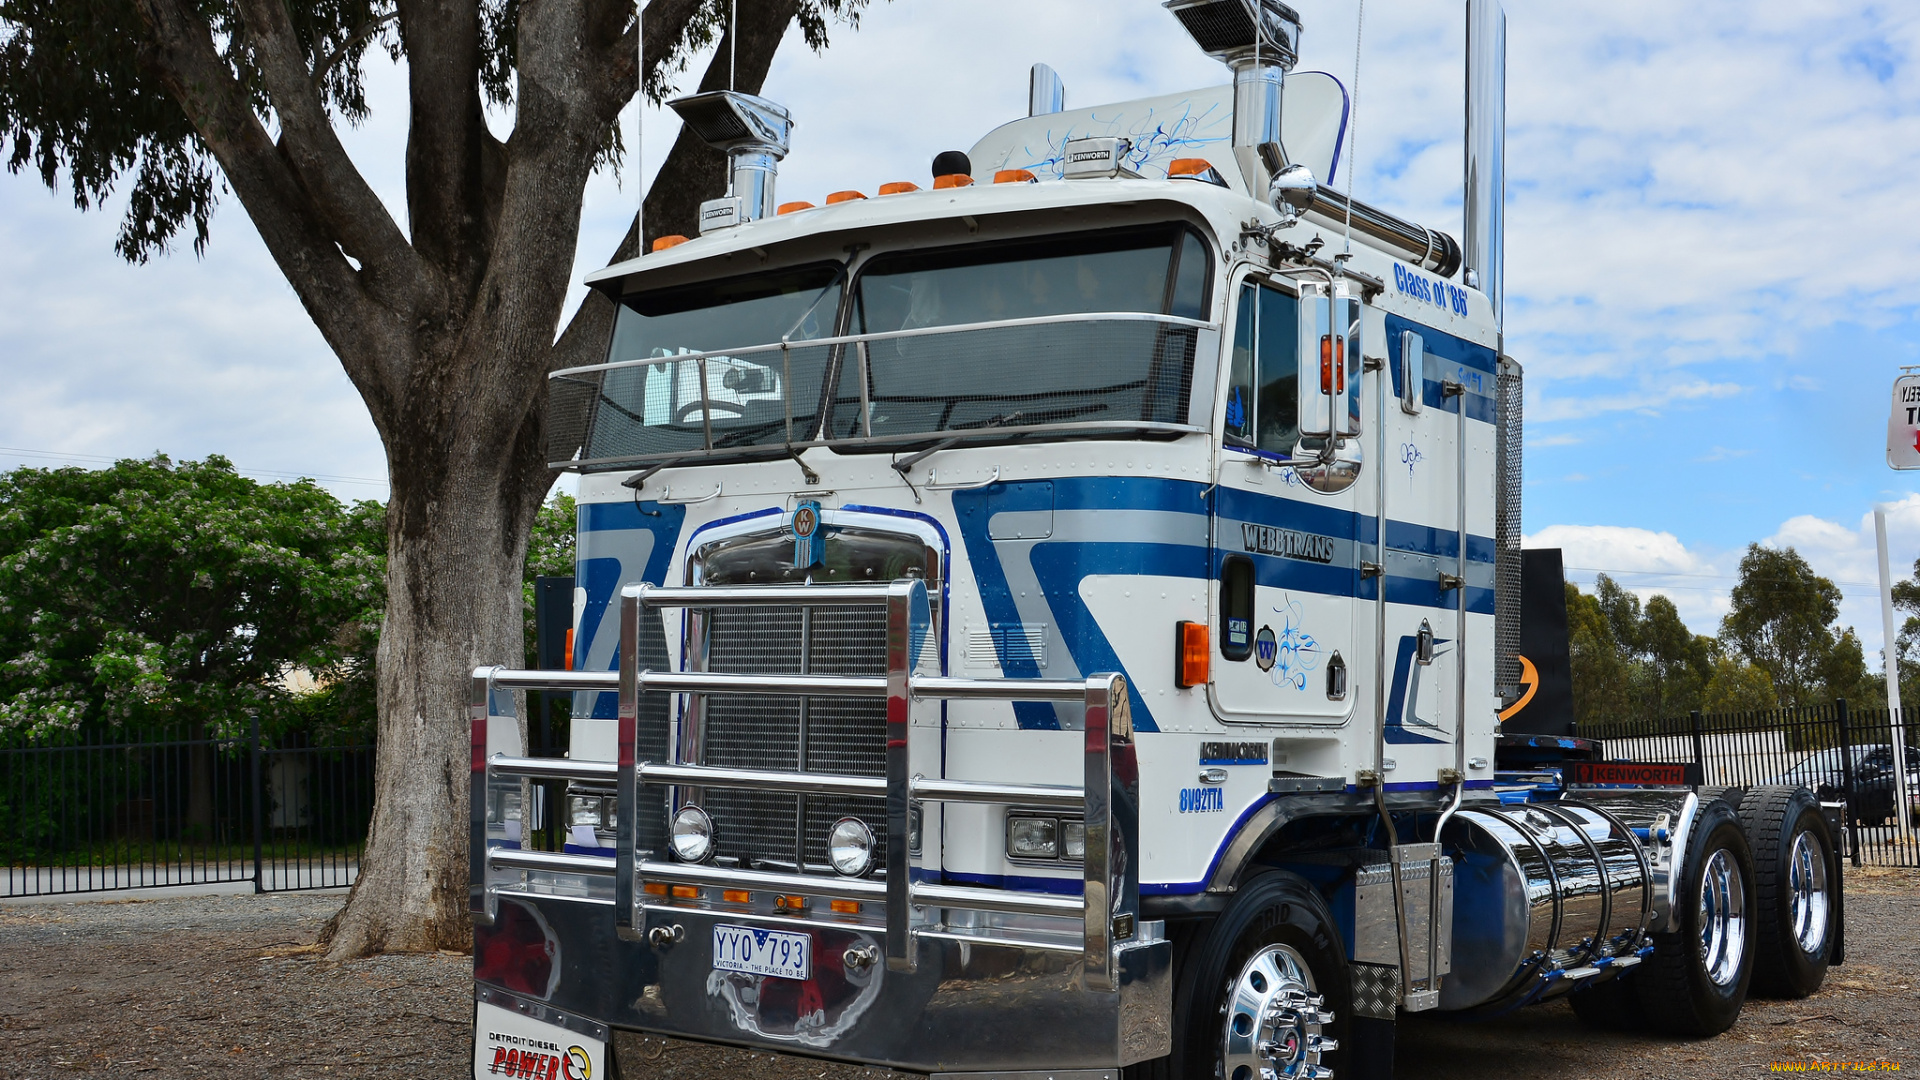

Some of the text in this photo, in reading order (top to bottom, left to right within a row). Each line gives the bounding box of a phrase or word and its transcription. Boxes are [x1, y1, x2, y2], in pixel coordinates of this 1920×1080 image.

[1073, 151, 1109, 161] KENWORTH
[1393, 262, 1432, 305] Class
[1433, 280, 1447, 311] of
[1241, 523, 1334, 564] WEBBTRANS
[1258, 640, 1275, 660] W
[1596, 767, 1681, 782] KENWORTH
[1179, 787, 1223, 813] 8V92TTA
[768, 937, 803, 969] 793
[716, 959, 743, 970] VICTORIA
[751, 964, 762, 973] THE
[764, 966, 783, 976] PLACE
[796, 970, 804, 978] BE
[488, 1031, 561, 1052] DETROIT DIESEL
[489, 1045, 560, 1080] POWER
